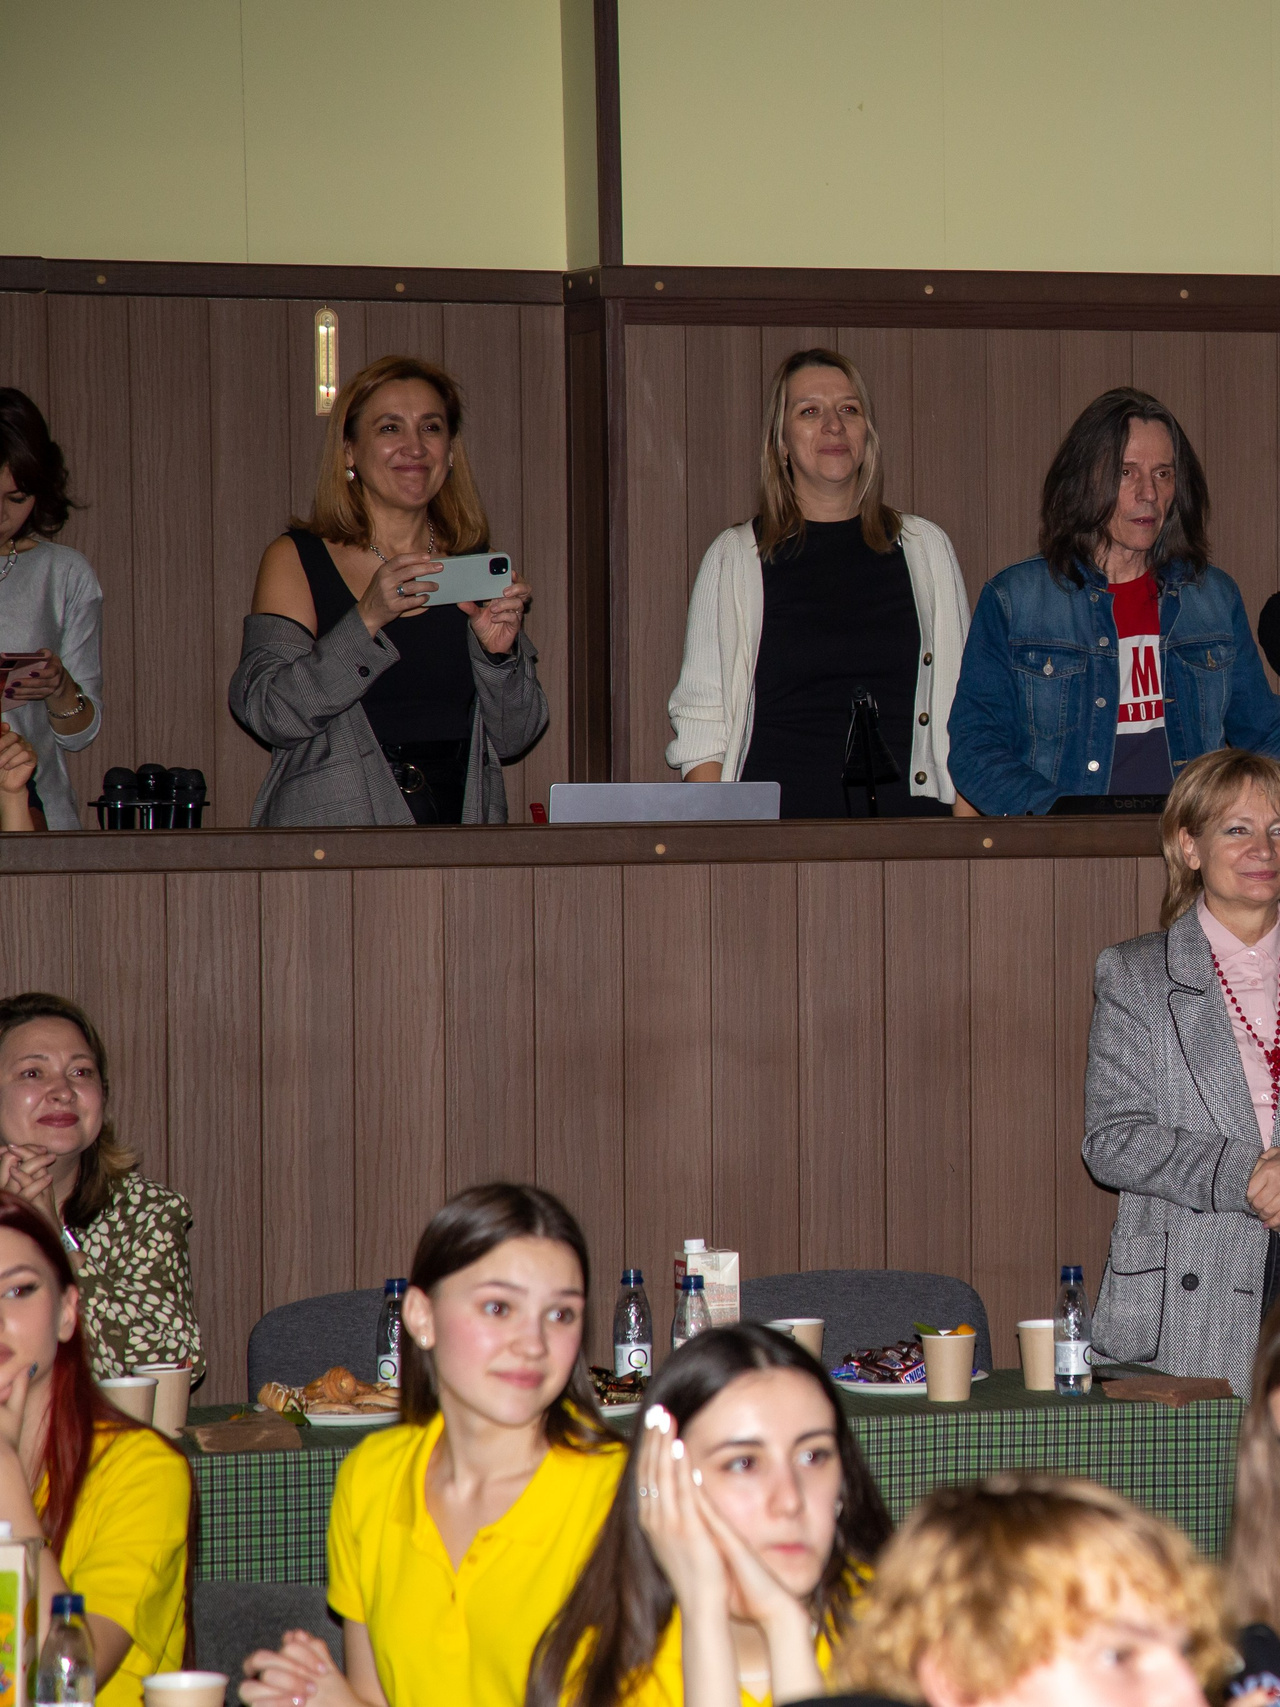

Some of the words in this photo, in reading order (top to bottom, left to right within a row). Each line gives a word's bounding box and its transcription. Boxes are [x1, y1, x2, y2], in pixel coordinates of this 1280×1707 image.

[1131, 646, 1160, 698] M
[379, 1359, 398, 1381] Q
[628, 1348, 648, 1370] Q
